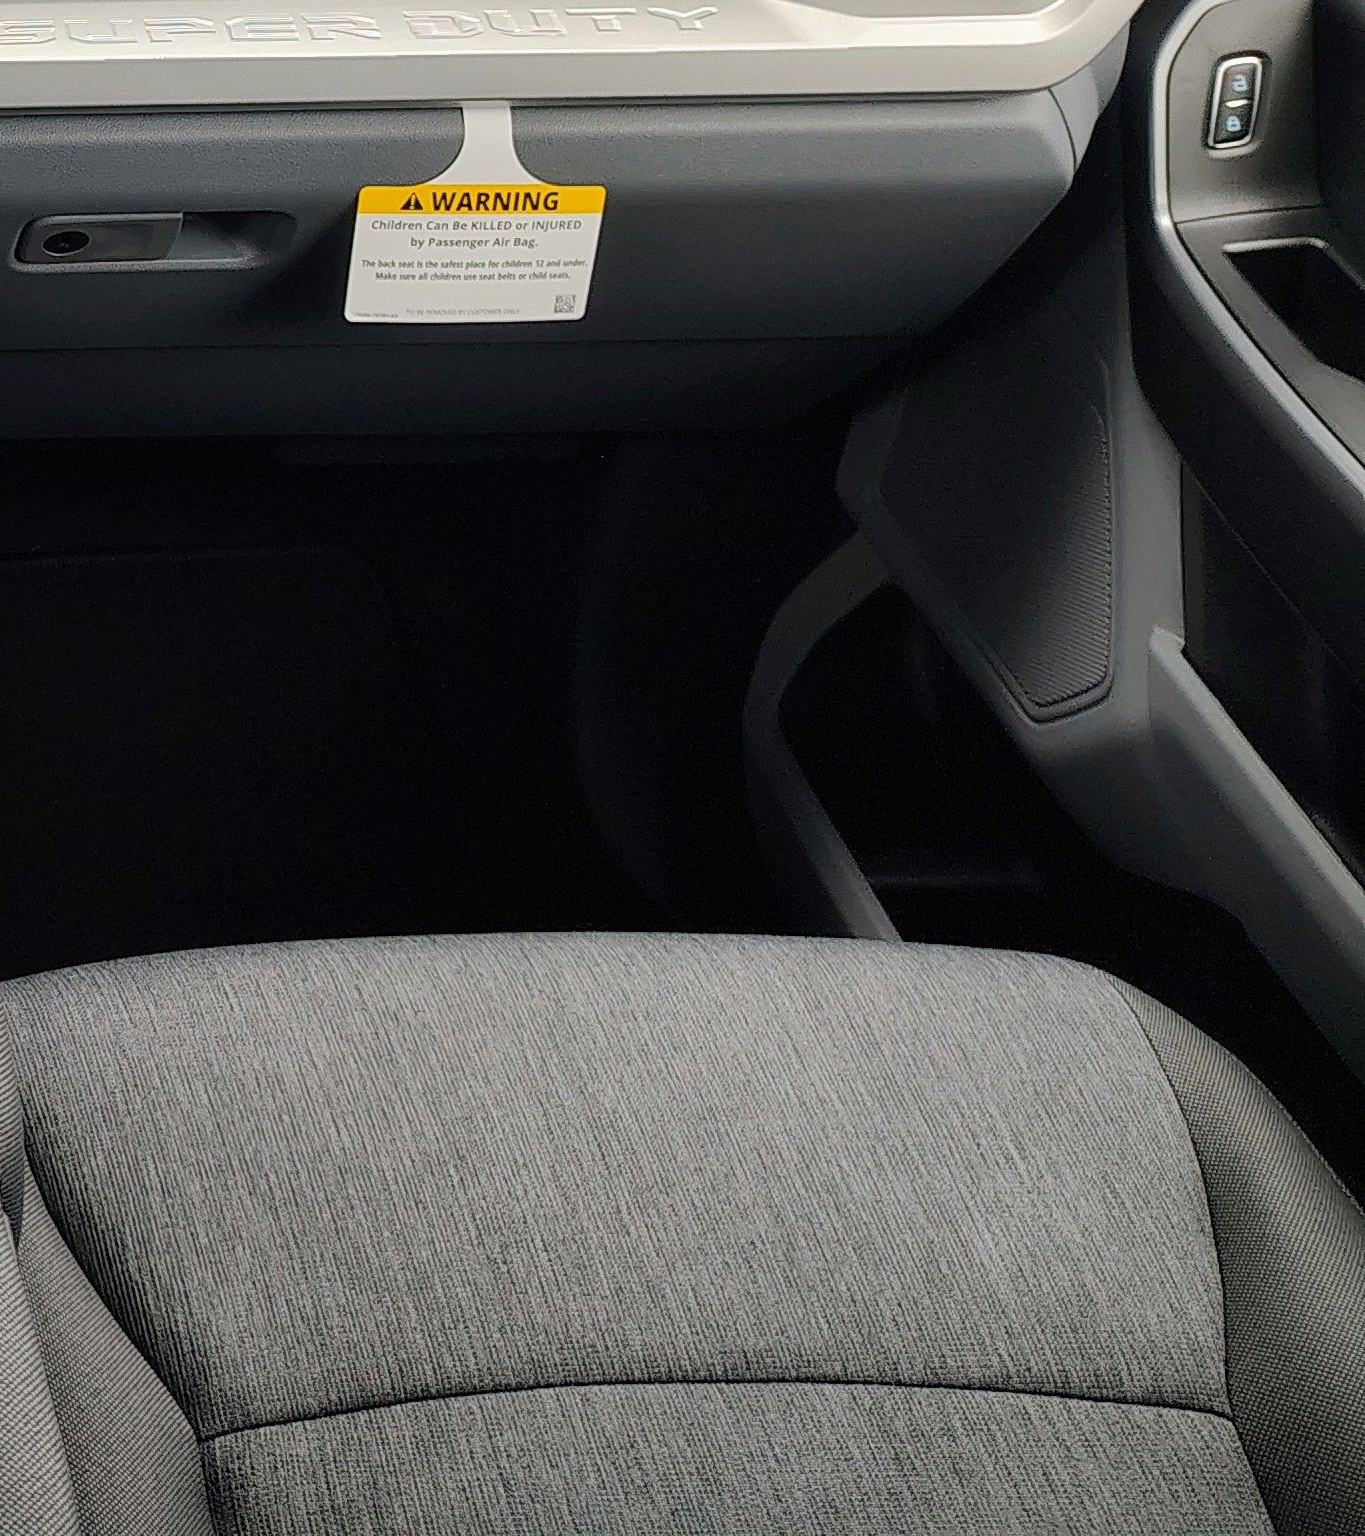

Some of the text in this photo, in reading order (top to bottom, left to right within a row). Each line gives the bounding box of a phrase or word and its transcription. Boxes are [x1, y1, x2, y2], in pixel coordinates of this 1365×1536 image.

[403, 4, 720, 38] DUTY
[431, 191, 560, 212] WARNING
[370, 219, 582, 231] Children Can Be KILLED or INJURED
[410, 237, 539, 249] by Passenger Air Bag.
[361, 259, 376, 268] The
[377, 259, 396, 269] back
[398, 260, 415, 269] seat
[425, 260, 439, 269] the
[440, 259, 464, 269] safest
[465, 260, 486, 271] place
[488, 260, 500, 269] for
[501, 259, 533, 269] children
[546, 259, 561, 268] and
[375, 272, 398, 281] Make
[399, 273, 416, 281] sure
[417, 272, 428, 281] all
[430, 272, 462, 281] children
[478, 273, 496, 281] seat
[497, 272, 517, 281] belts
[518, 273, 528, 281] or
[528, 272, 548, 281] child
[549, 272, 571, 280] seats.
